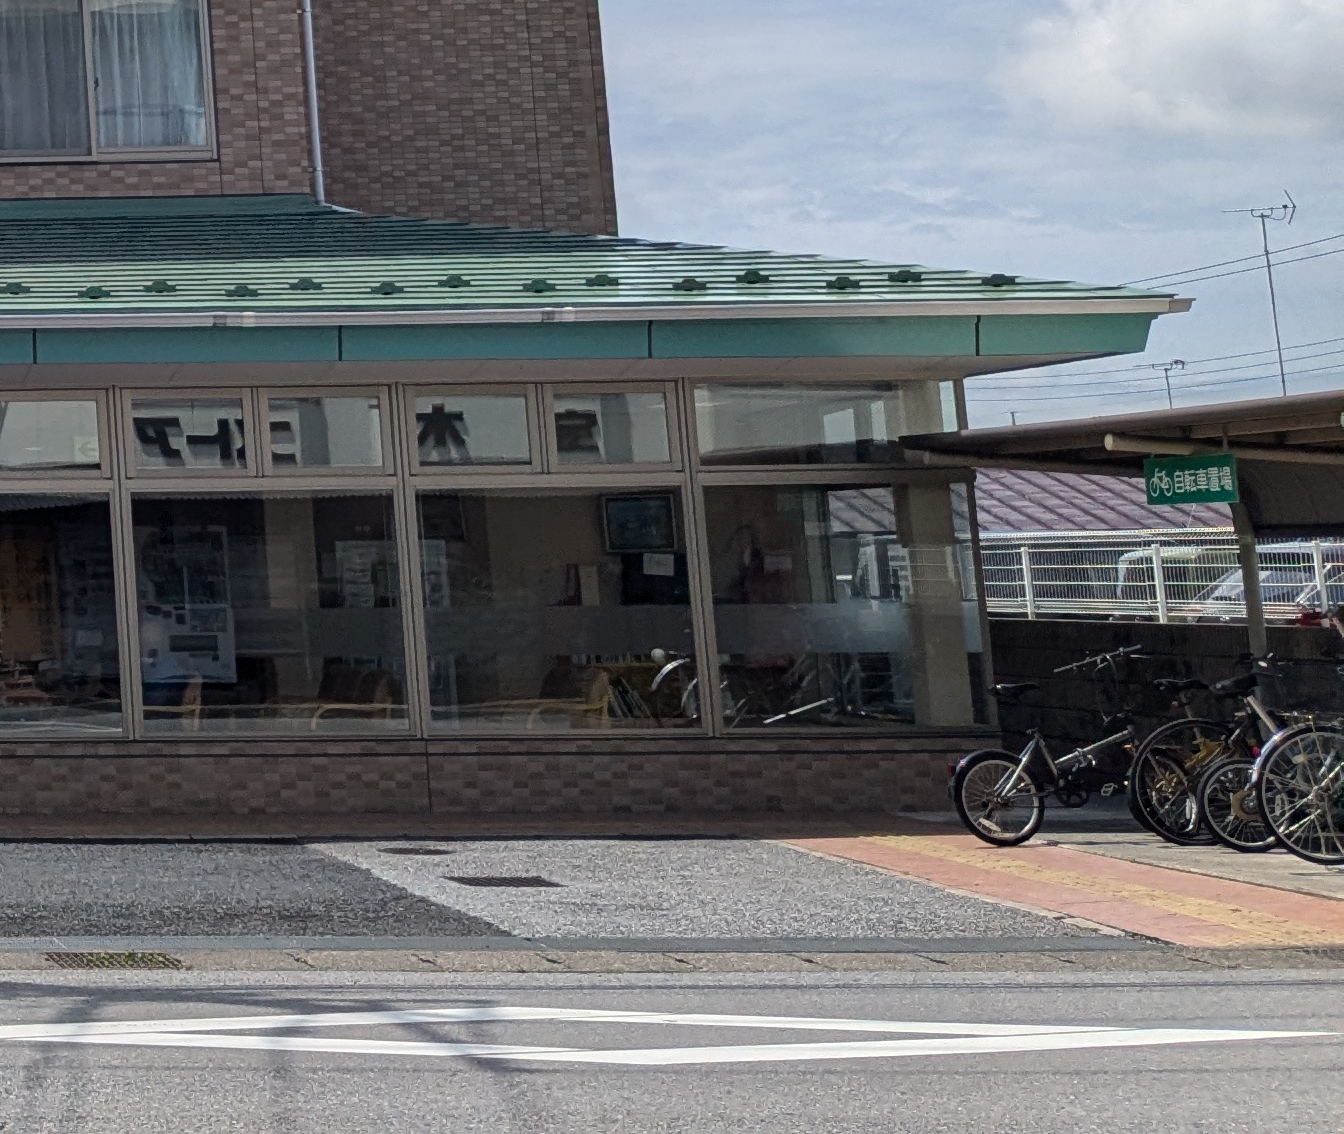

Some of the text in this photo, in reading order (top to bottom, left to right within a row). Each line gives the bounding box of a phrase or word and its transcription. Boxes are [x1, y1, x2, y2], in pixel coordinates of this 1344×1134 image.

[1173, 466, 1233, 493] 自転車置場
